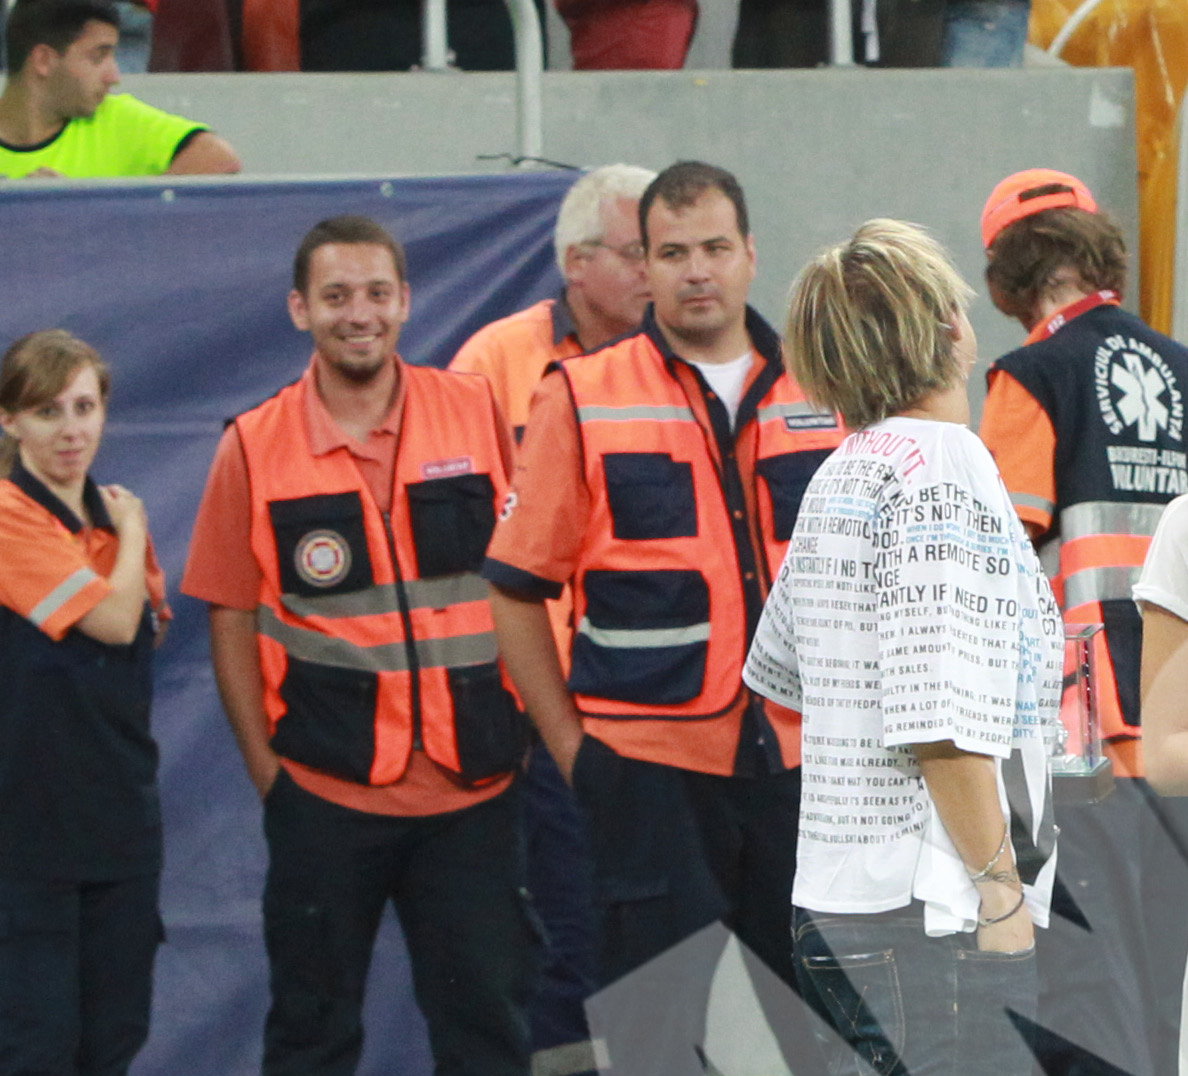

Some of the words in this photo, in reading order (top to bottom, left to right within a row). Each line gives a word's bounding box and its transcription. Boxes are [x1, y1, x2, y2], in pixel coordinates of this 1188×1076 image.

[919, 485, 940, 503] BE
[897, 504, 925, 526] IT'S
[931, 502, 961, 523] NOT
[966, 508, 1002, 535] THEN
[908, 546, 919, 563] A
[925, 543, 981, 572] REMOTE
[985, 556, 1011, 576] SO
[933, 583, 947, 602] IF
[955, 586, 988, 613] NEED
[996, 598, 1017, 618] TO
[908, 624, 947, 636] ALWAYS
[982, 637, 1006, 650] THAT
[984, 617, 1007, 632] LIKE
[912, 642, 950, 655] AMOUNT
[988, 658, 1008, 669] BUT
[910, 683, 920, 693] IN
[924, 681, 942, 692] THE
[979, 694, 987, 703] IT
[991, 695, 1012, 708] WAS
[910, 702, 917, 711] A
[919, 701, 938, 711] LOT
[896, 719, 944, 733] REMINDED
